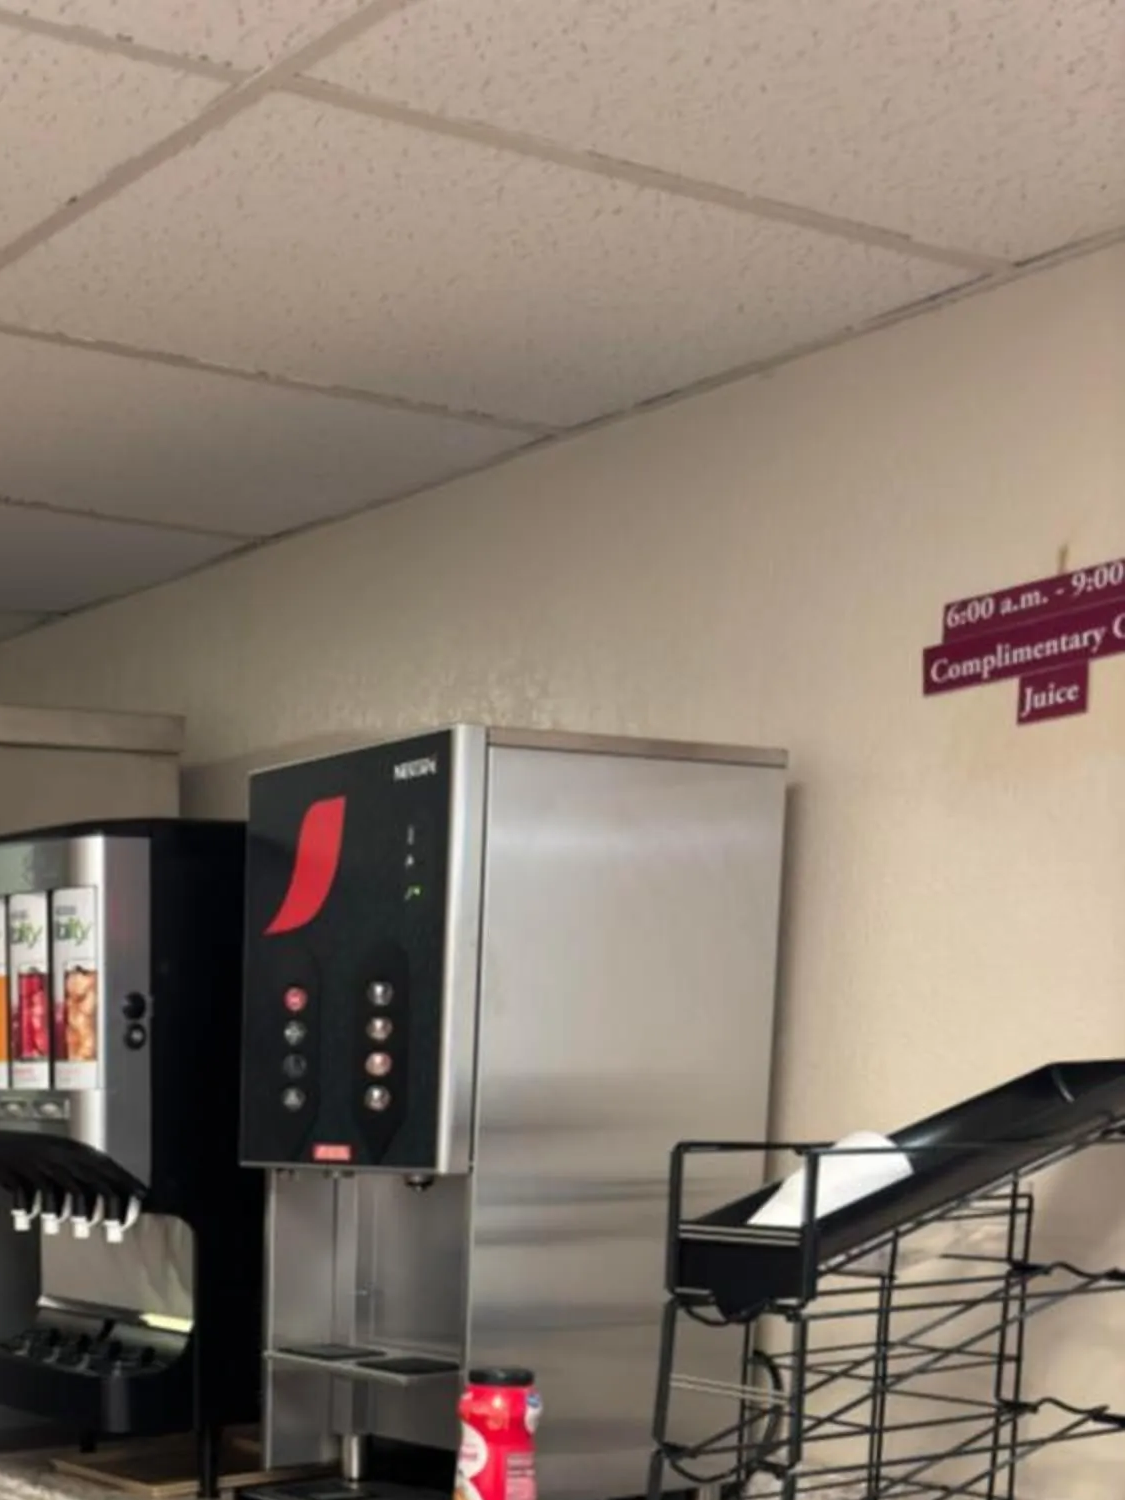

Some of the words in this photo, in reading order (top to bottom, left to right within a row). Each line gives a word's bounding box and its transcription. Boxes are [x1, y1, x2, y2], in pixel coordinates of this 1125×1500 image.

[946, 597, 994, 628] 6:00
[1000, 589, 1049, 615] a.m.
[1071, 562, 1124, 597] 9:00
[930, 626, 1106, 683] Complimentary
[1021, 682, 1079, 717] Juice
